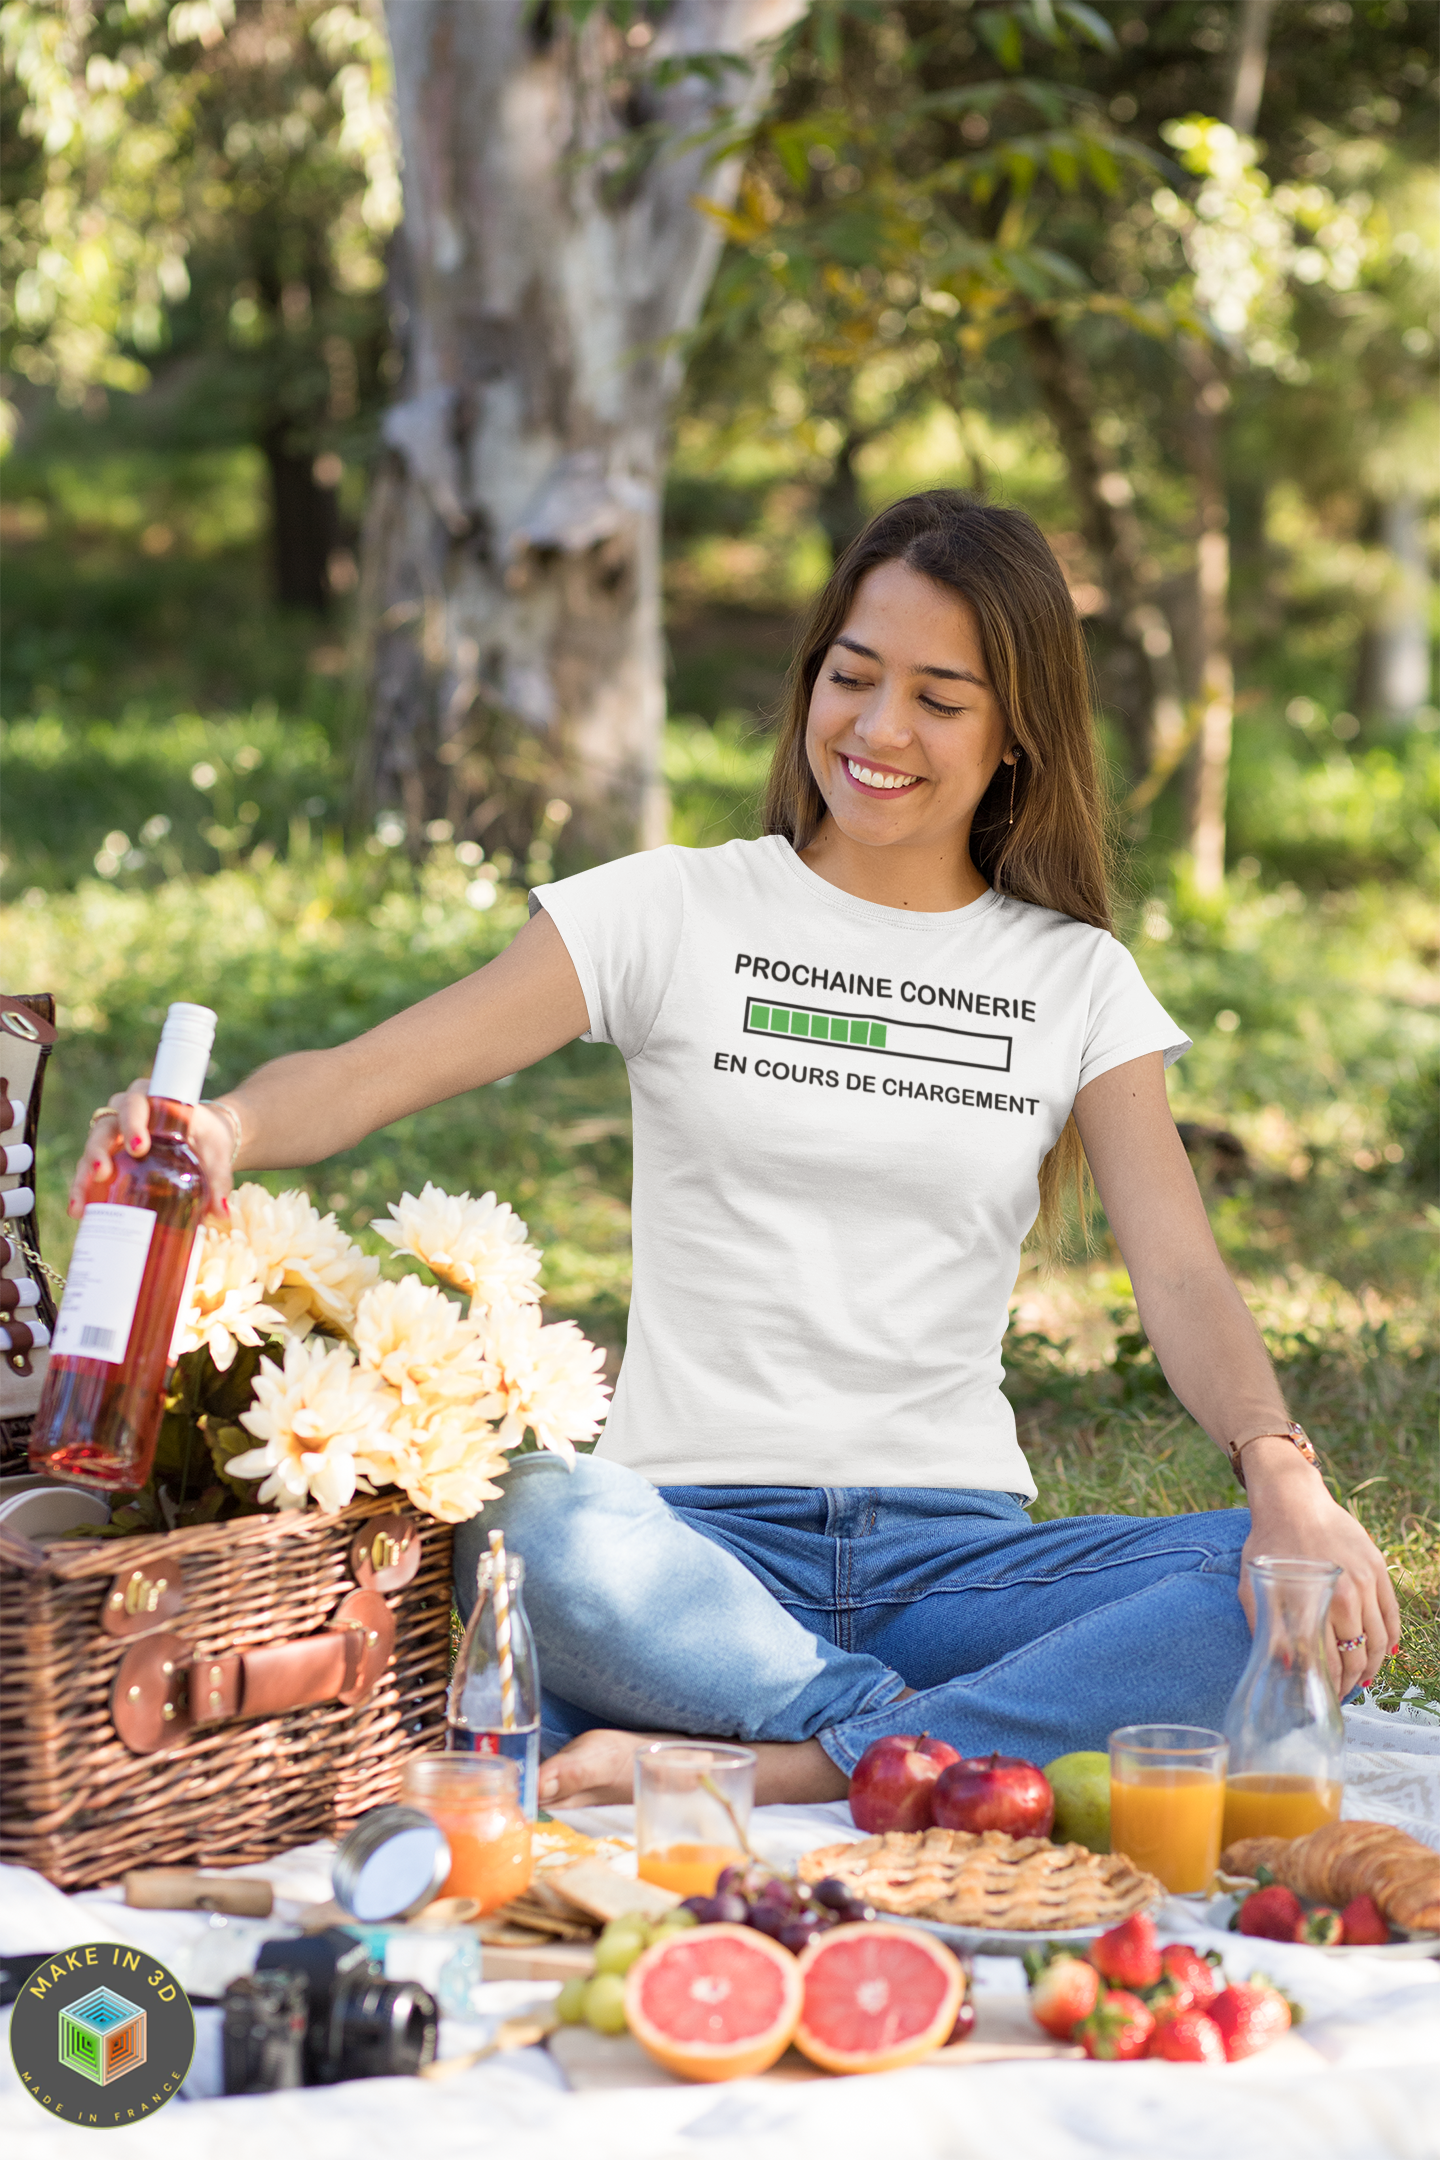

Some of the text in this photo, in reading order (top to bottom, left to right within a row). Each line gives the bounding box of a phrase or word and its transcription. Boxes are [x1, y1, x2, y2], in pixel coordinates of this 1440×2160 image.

[735, 953, 1037, 1022] PROCHAINE CONNERIE
[713, 1052, 1040, 1115] EN COURS DE CHARGEMENT
